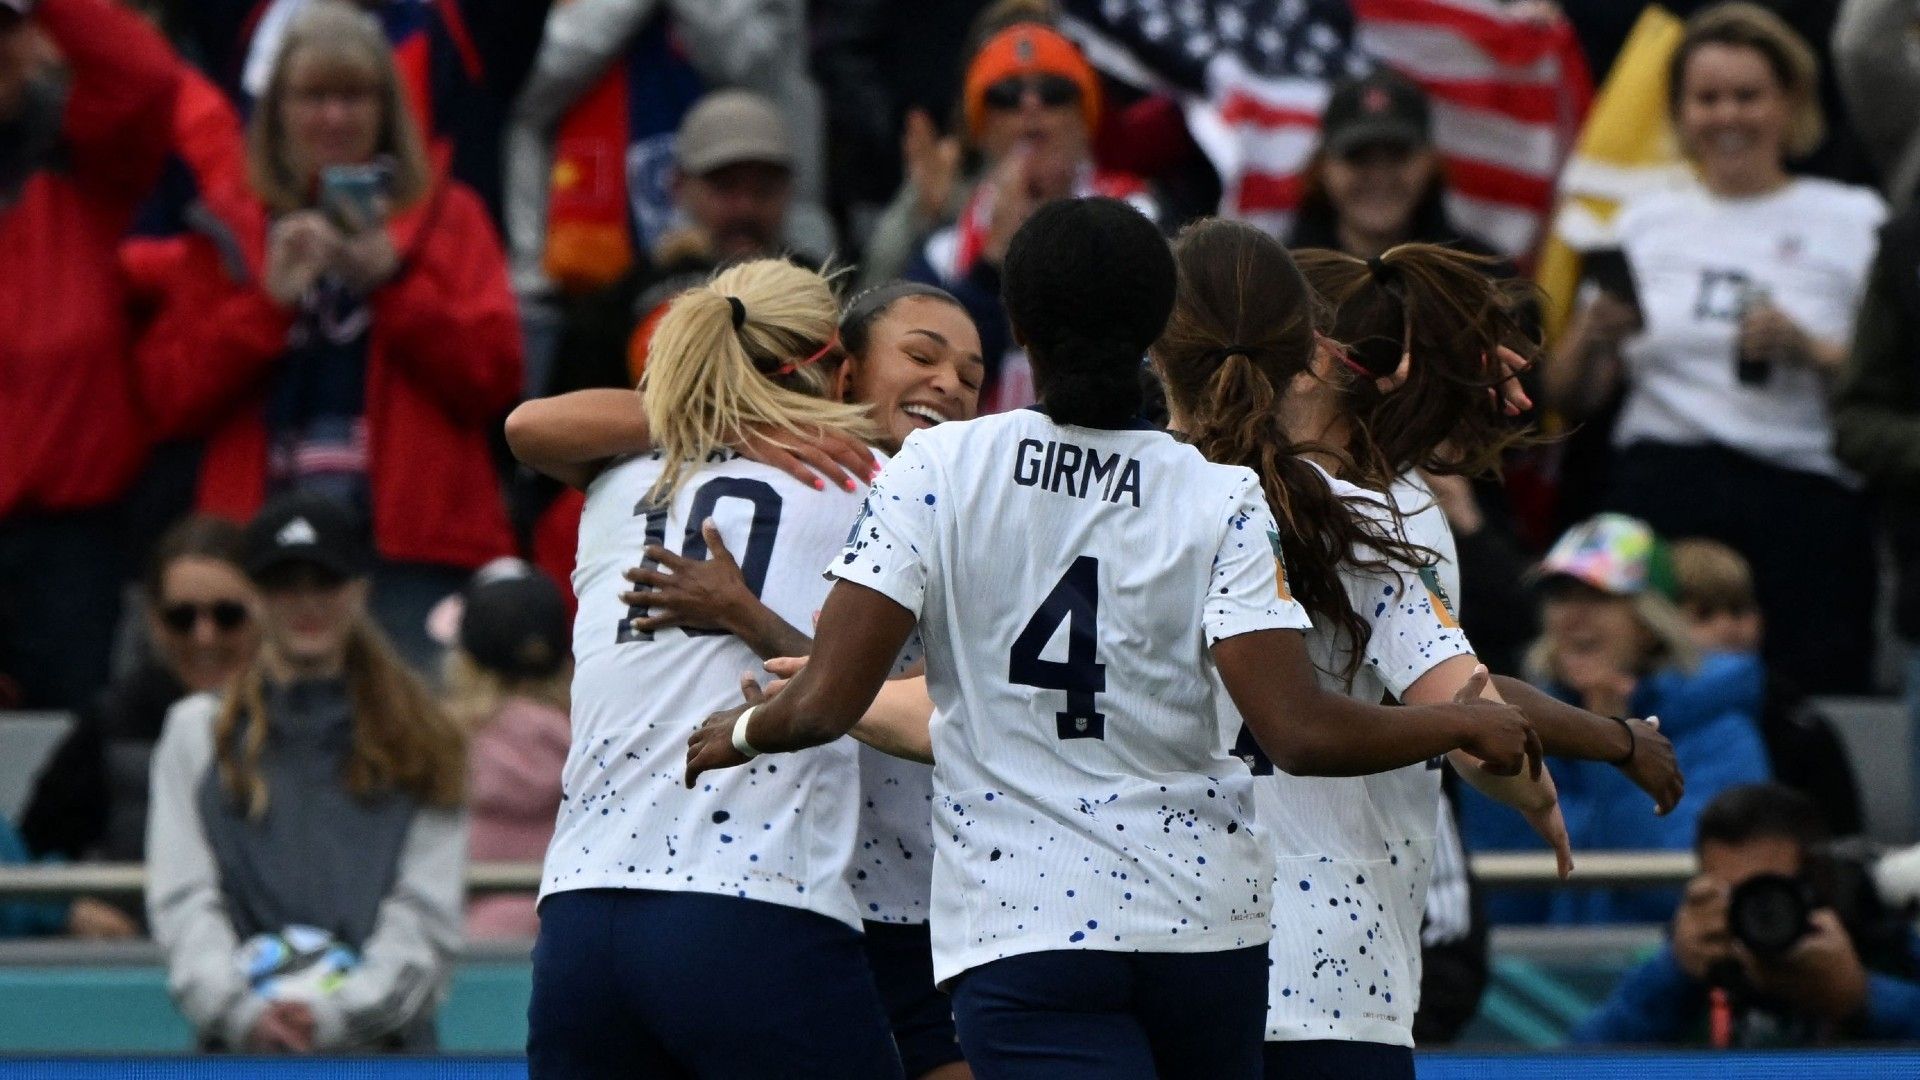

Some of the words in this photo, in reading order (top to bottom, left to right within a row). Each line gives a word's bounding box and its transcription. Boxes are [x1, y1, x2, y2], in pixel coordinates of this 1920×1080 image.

[1013, 438, 1141, 508] GIRMA
[615, 476, 783, 644] 10
[1008, 555, 1106, 741] 4
